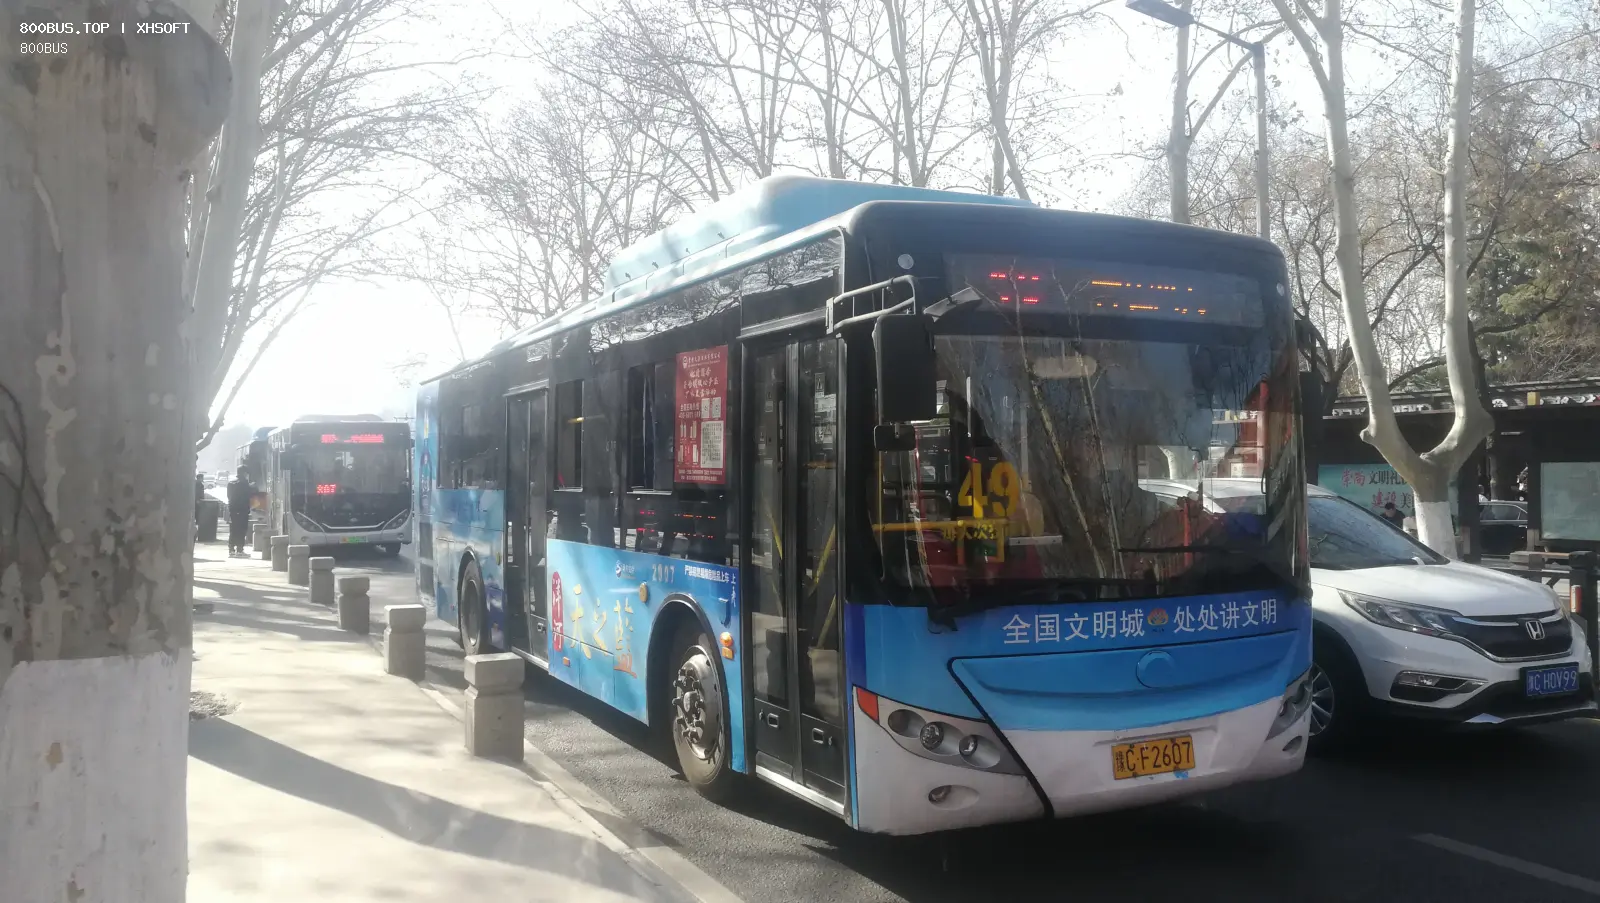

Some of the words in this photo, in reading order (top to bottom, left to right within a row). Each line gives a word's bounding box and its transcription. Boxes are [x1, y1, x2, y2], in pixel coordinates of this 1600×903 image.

[958, 462, 1020, 518] 49
[1371, 488, 1415, 510] 建设美
[1002, 607, 1146, 645] 全国文明城
[1173, 598, 1278, 634] 处处讲文明
